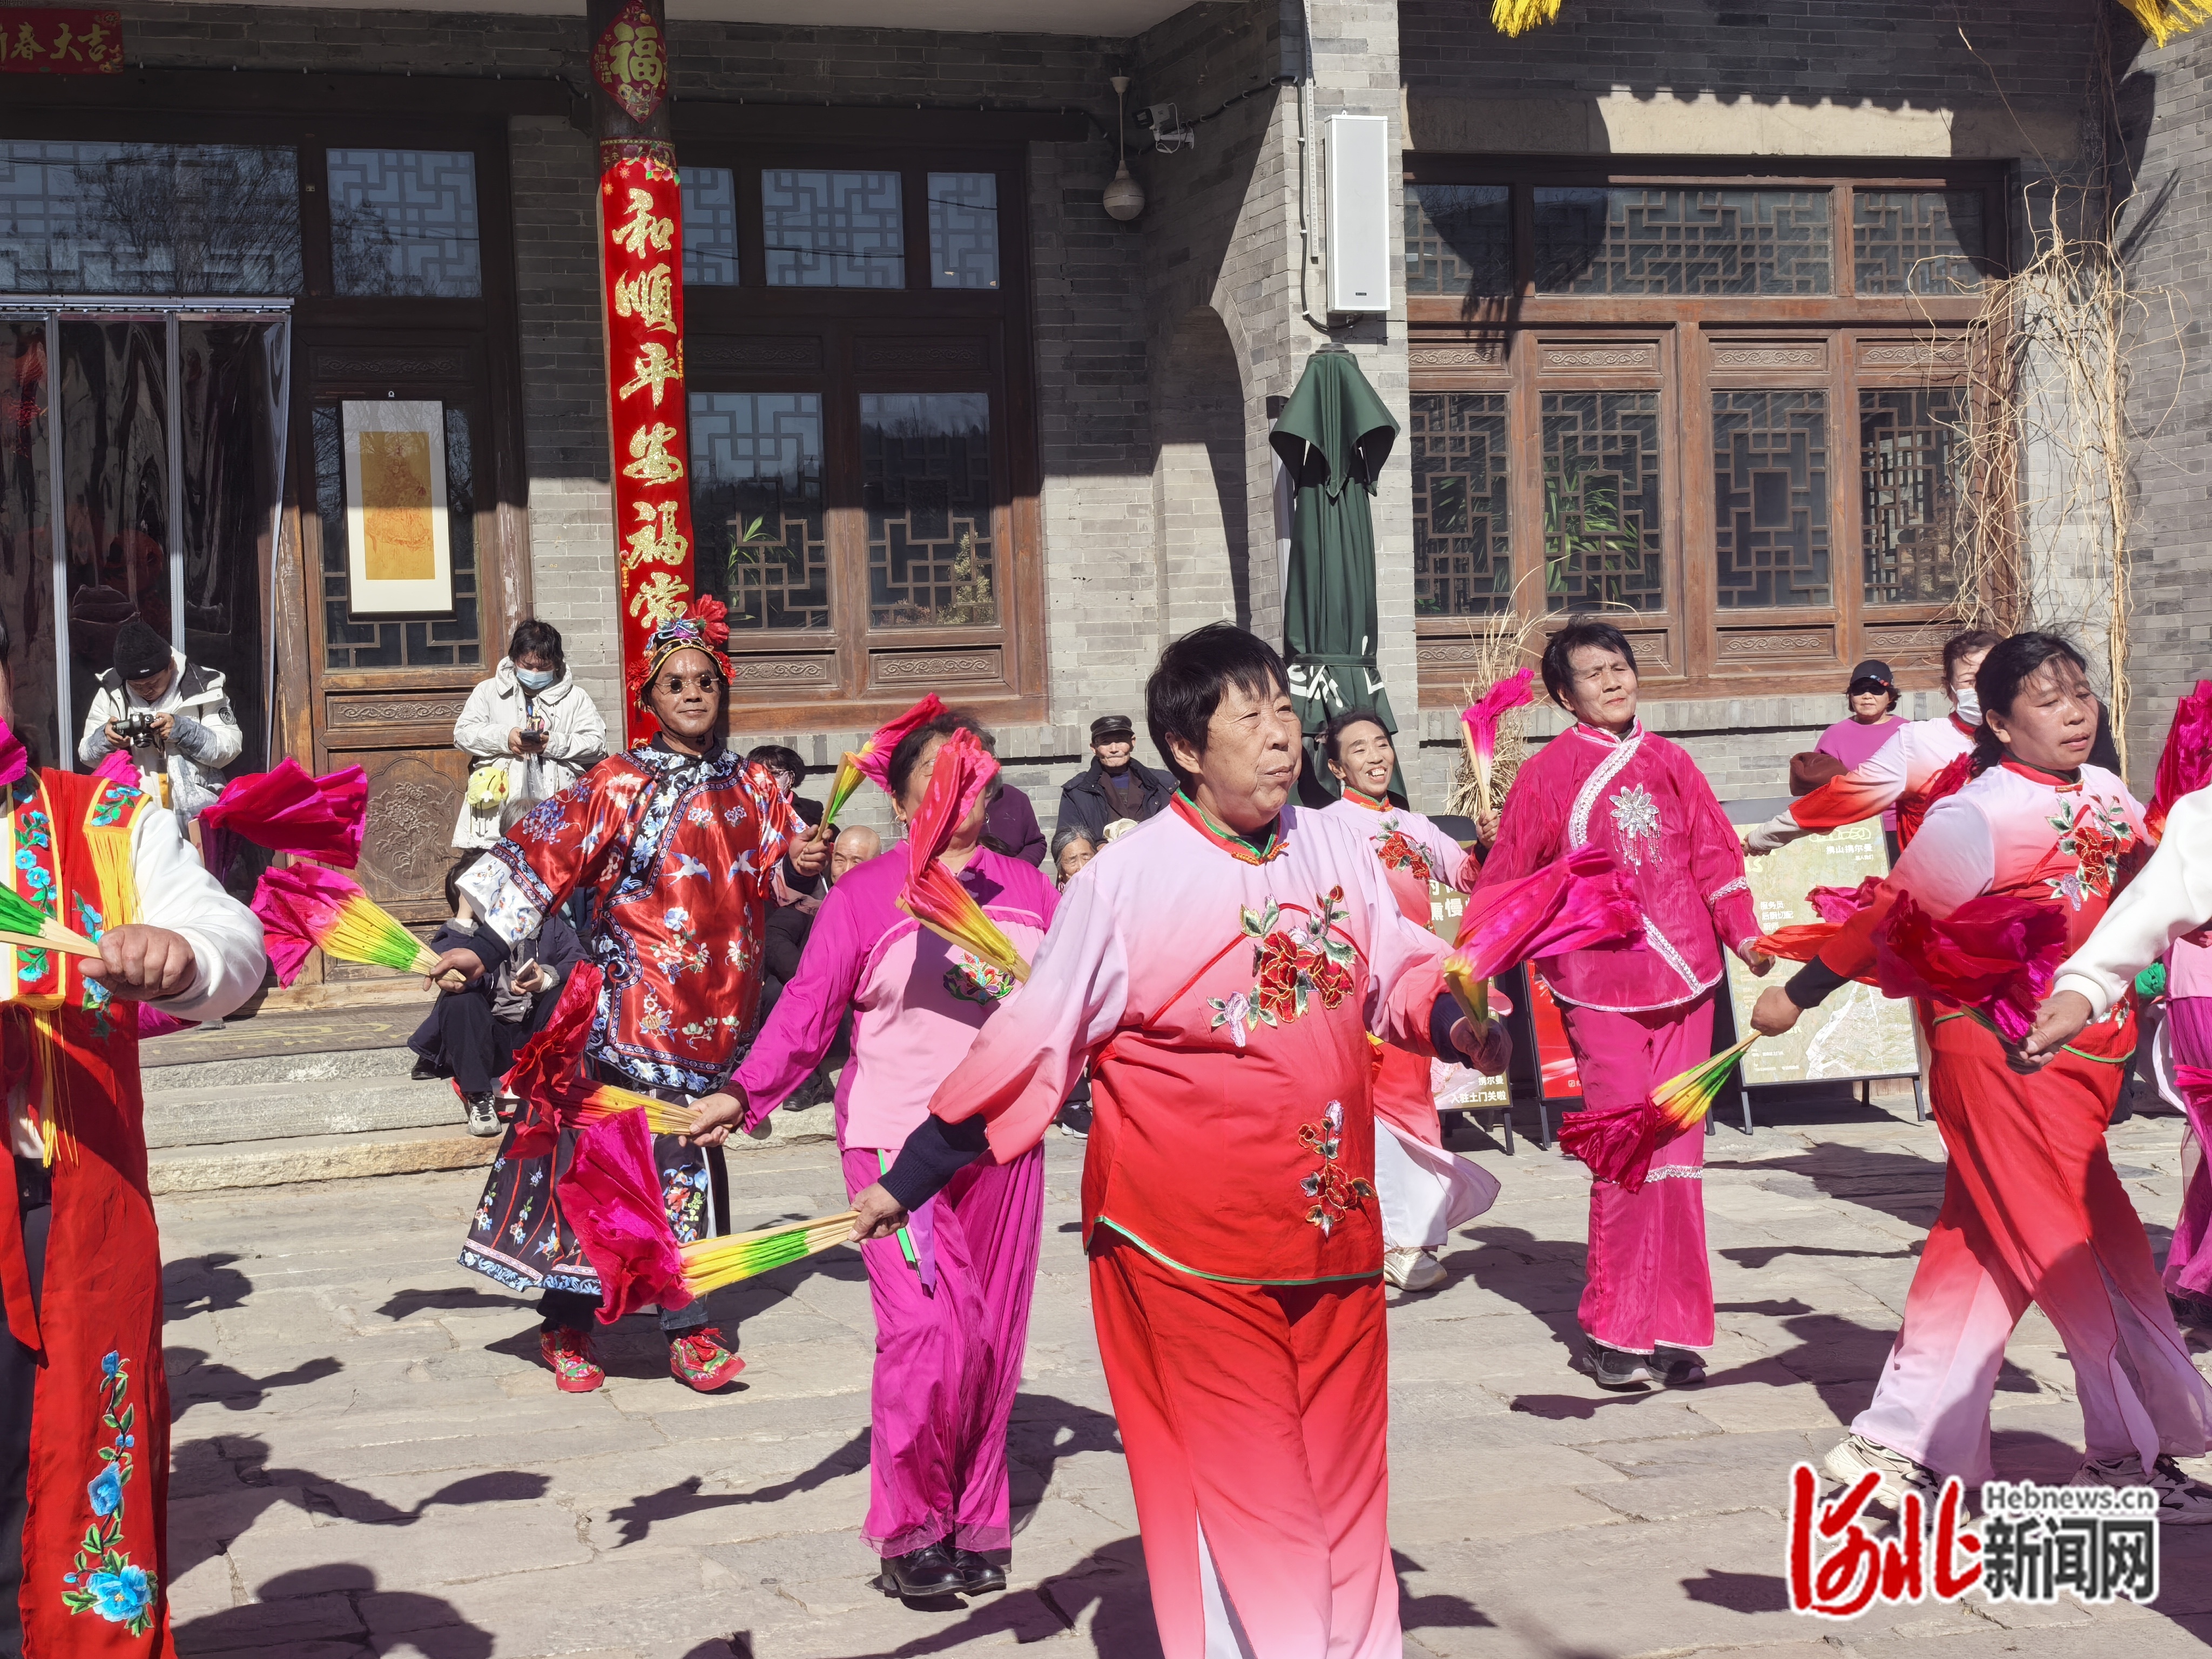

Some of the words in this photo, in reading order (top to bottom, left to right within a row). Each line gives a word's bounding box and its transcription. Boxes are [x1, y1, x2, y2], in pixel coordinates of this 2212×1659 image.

[609, 21, 663, 85] 福
[1451, 1090, 1507, 1104] 入驻土门关啦
